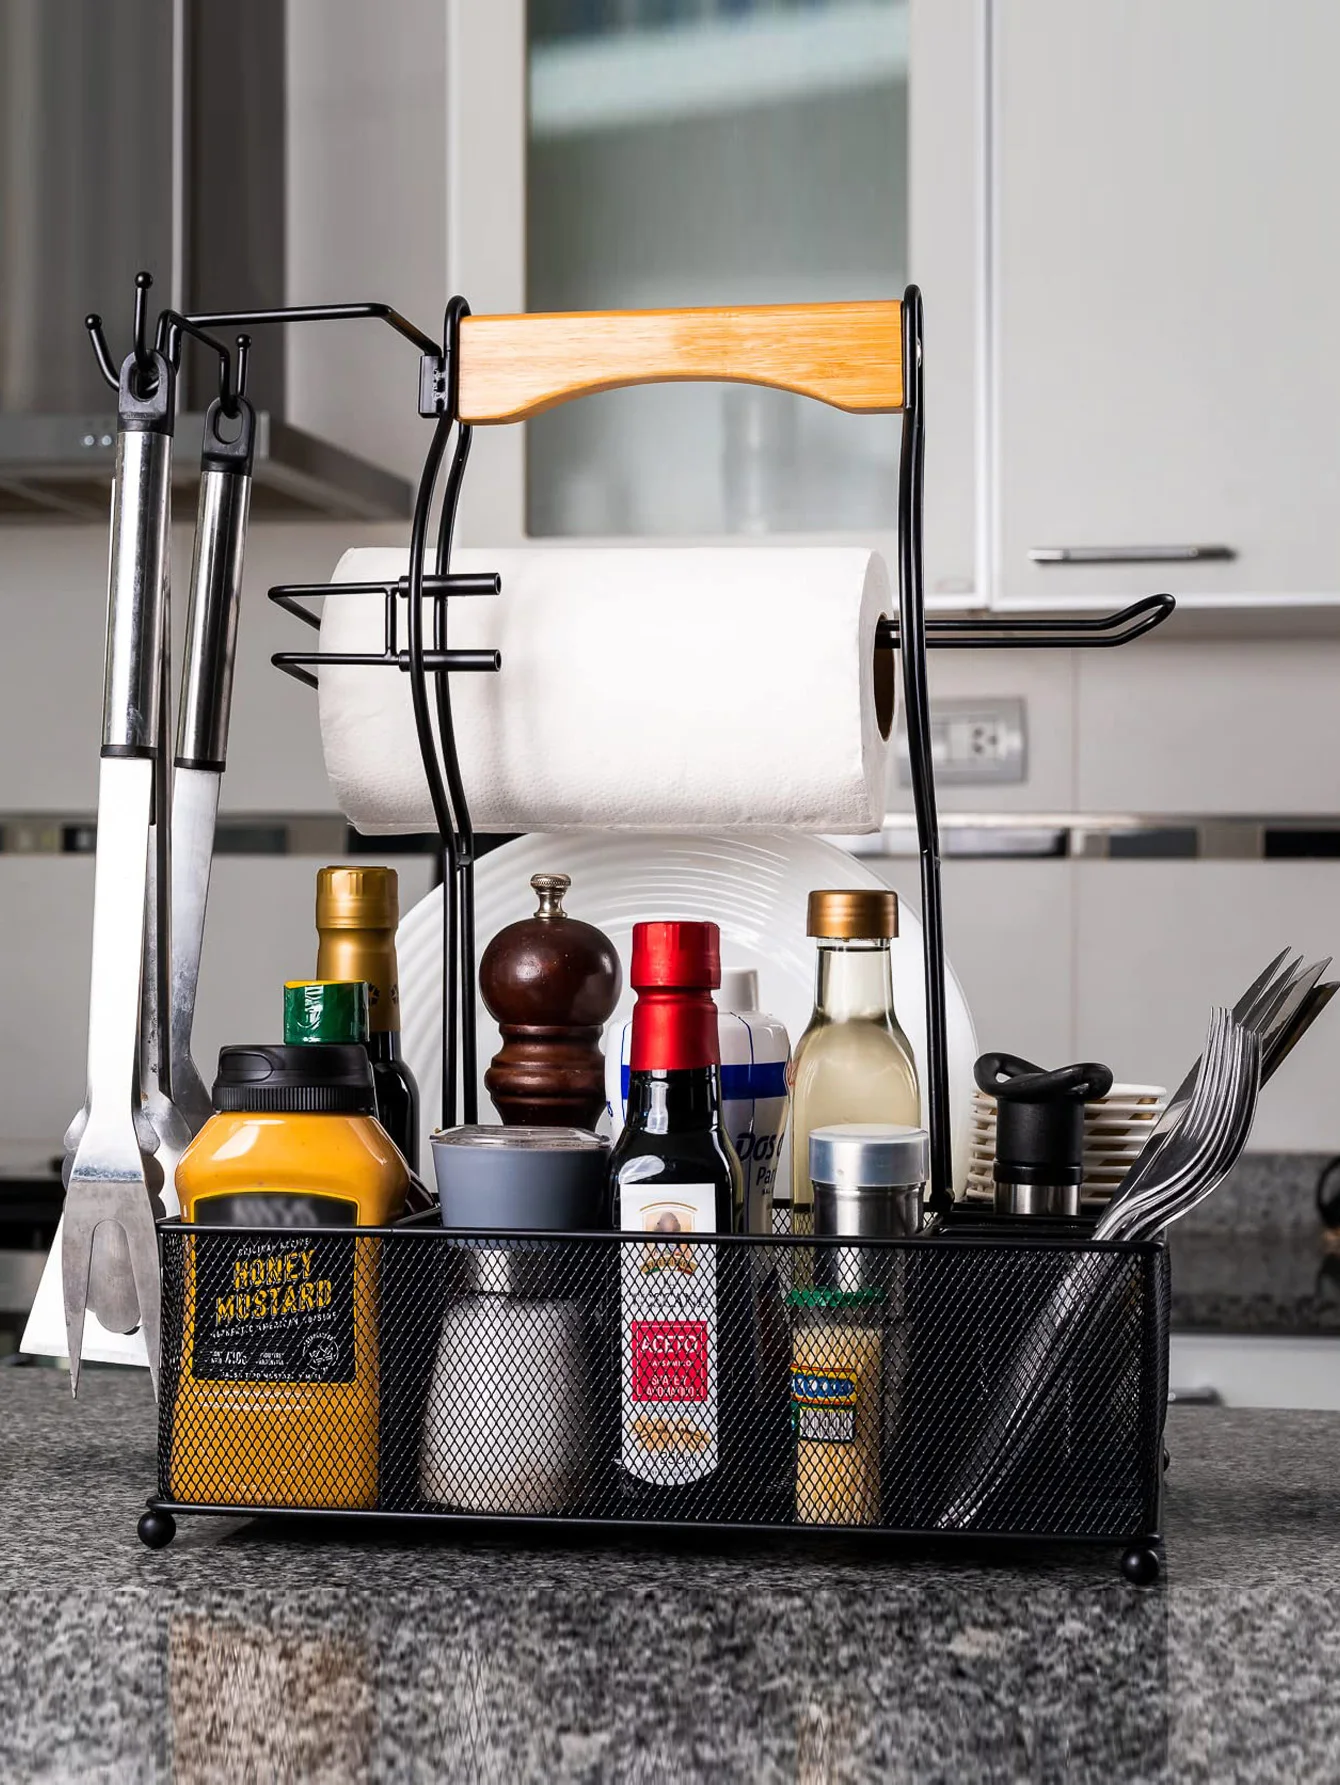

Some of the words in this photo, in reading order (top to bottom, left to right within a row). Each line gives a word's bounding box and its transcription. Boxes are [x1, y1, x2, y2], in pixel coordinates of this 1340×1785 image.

[233, 1249, 316, 1290] HONEY
[215, 1280, 332, 1325] MUSTARD
[640, 1335, 699, 1354] ACETO
